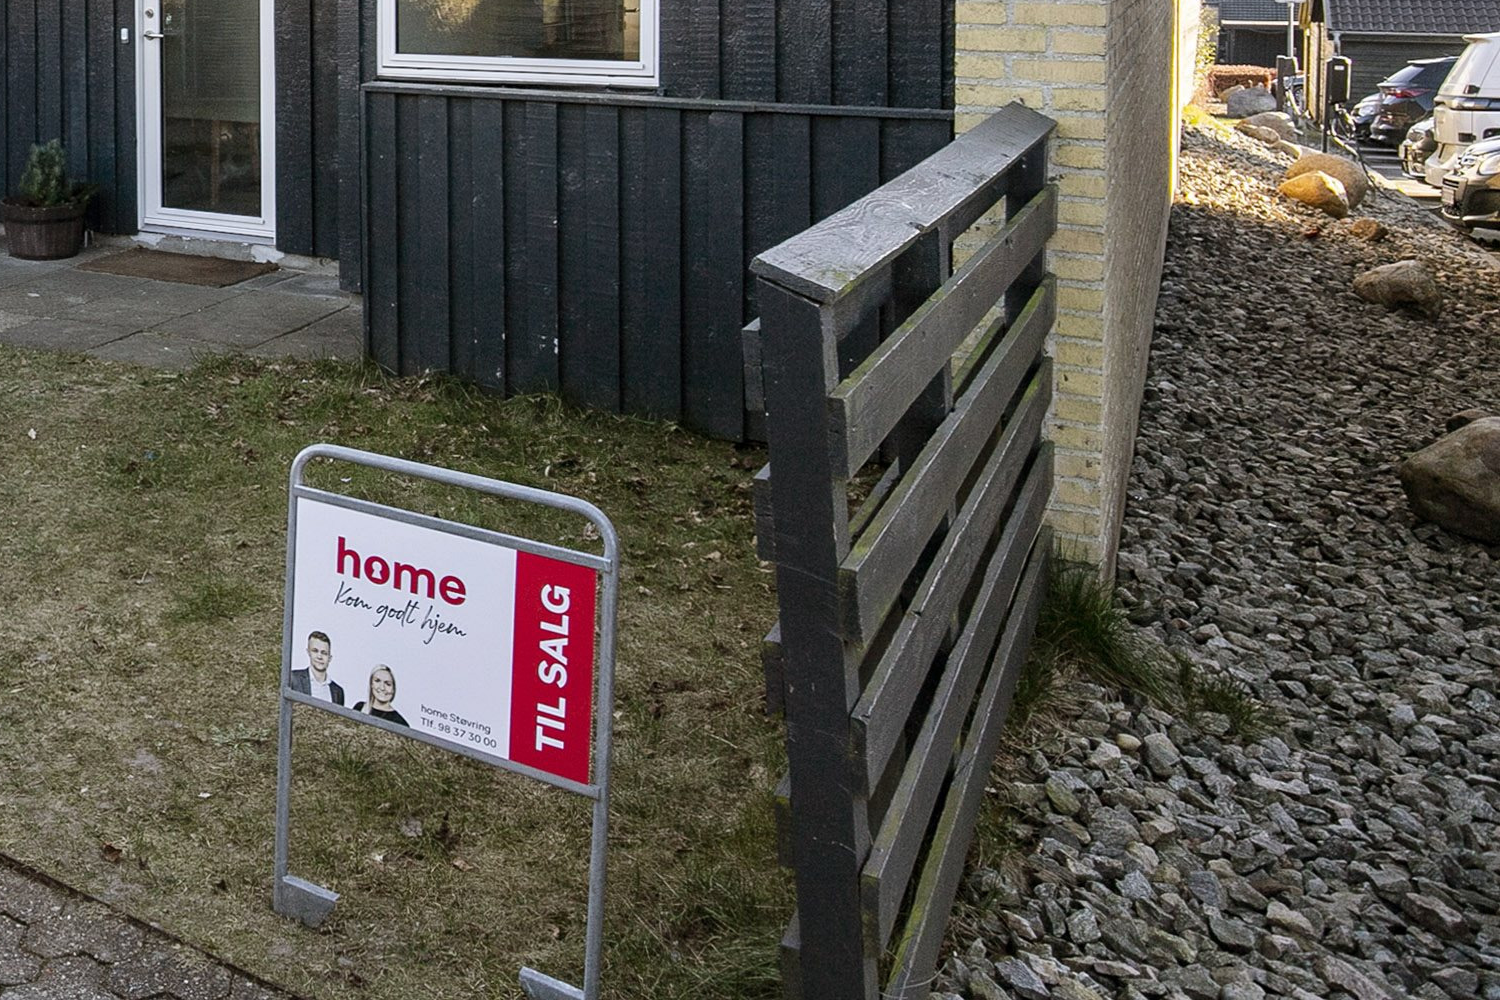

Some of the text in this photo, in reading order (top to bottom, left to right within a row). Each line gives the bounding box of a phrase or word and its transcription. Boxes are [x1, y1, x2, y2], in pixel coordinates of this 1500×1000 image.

[336, 536, 467, 605] home
[334, 581, 467, 645] Kom godt hjem
[535, 584, 571, 752] TIL SALG
[420, 704, 491, 736] home Støvring
[438, 722, 451, 734] 98
[453, 727, 466, 738] 37
[468, 732, 482, 744] 30
[483, 737, 497, 748] 00
